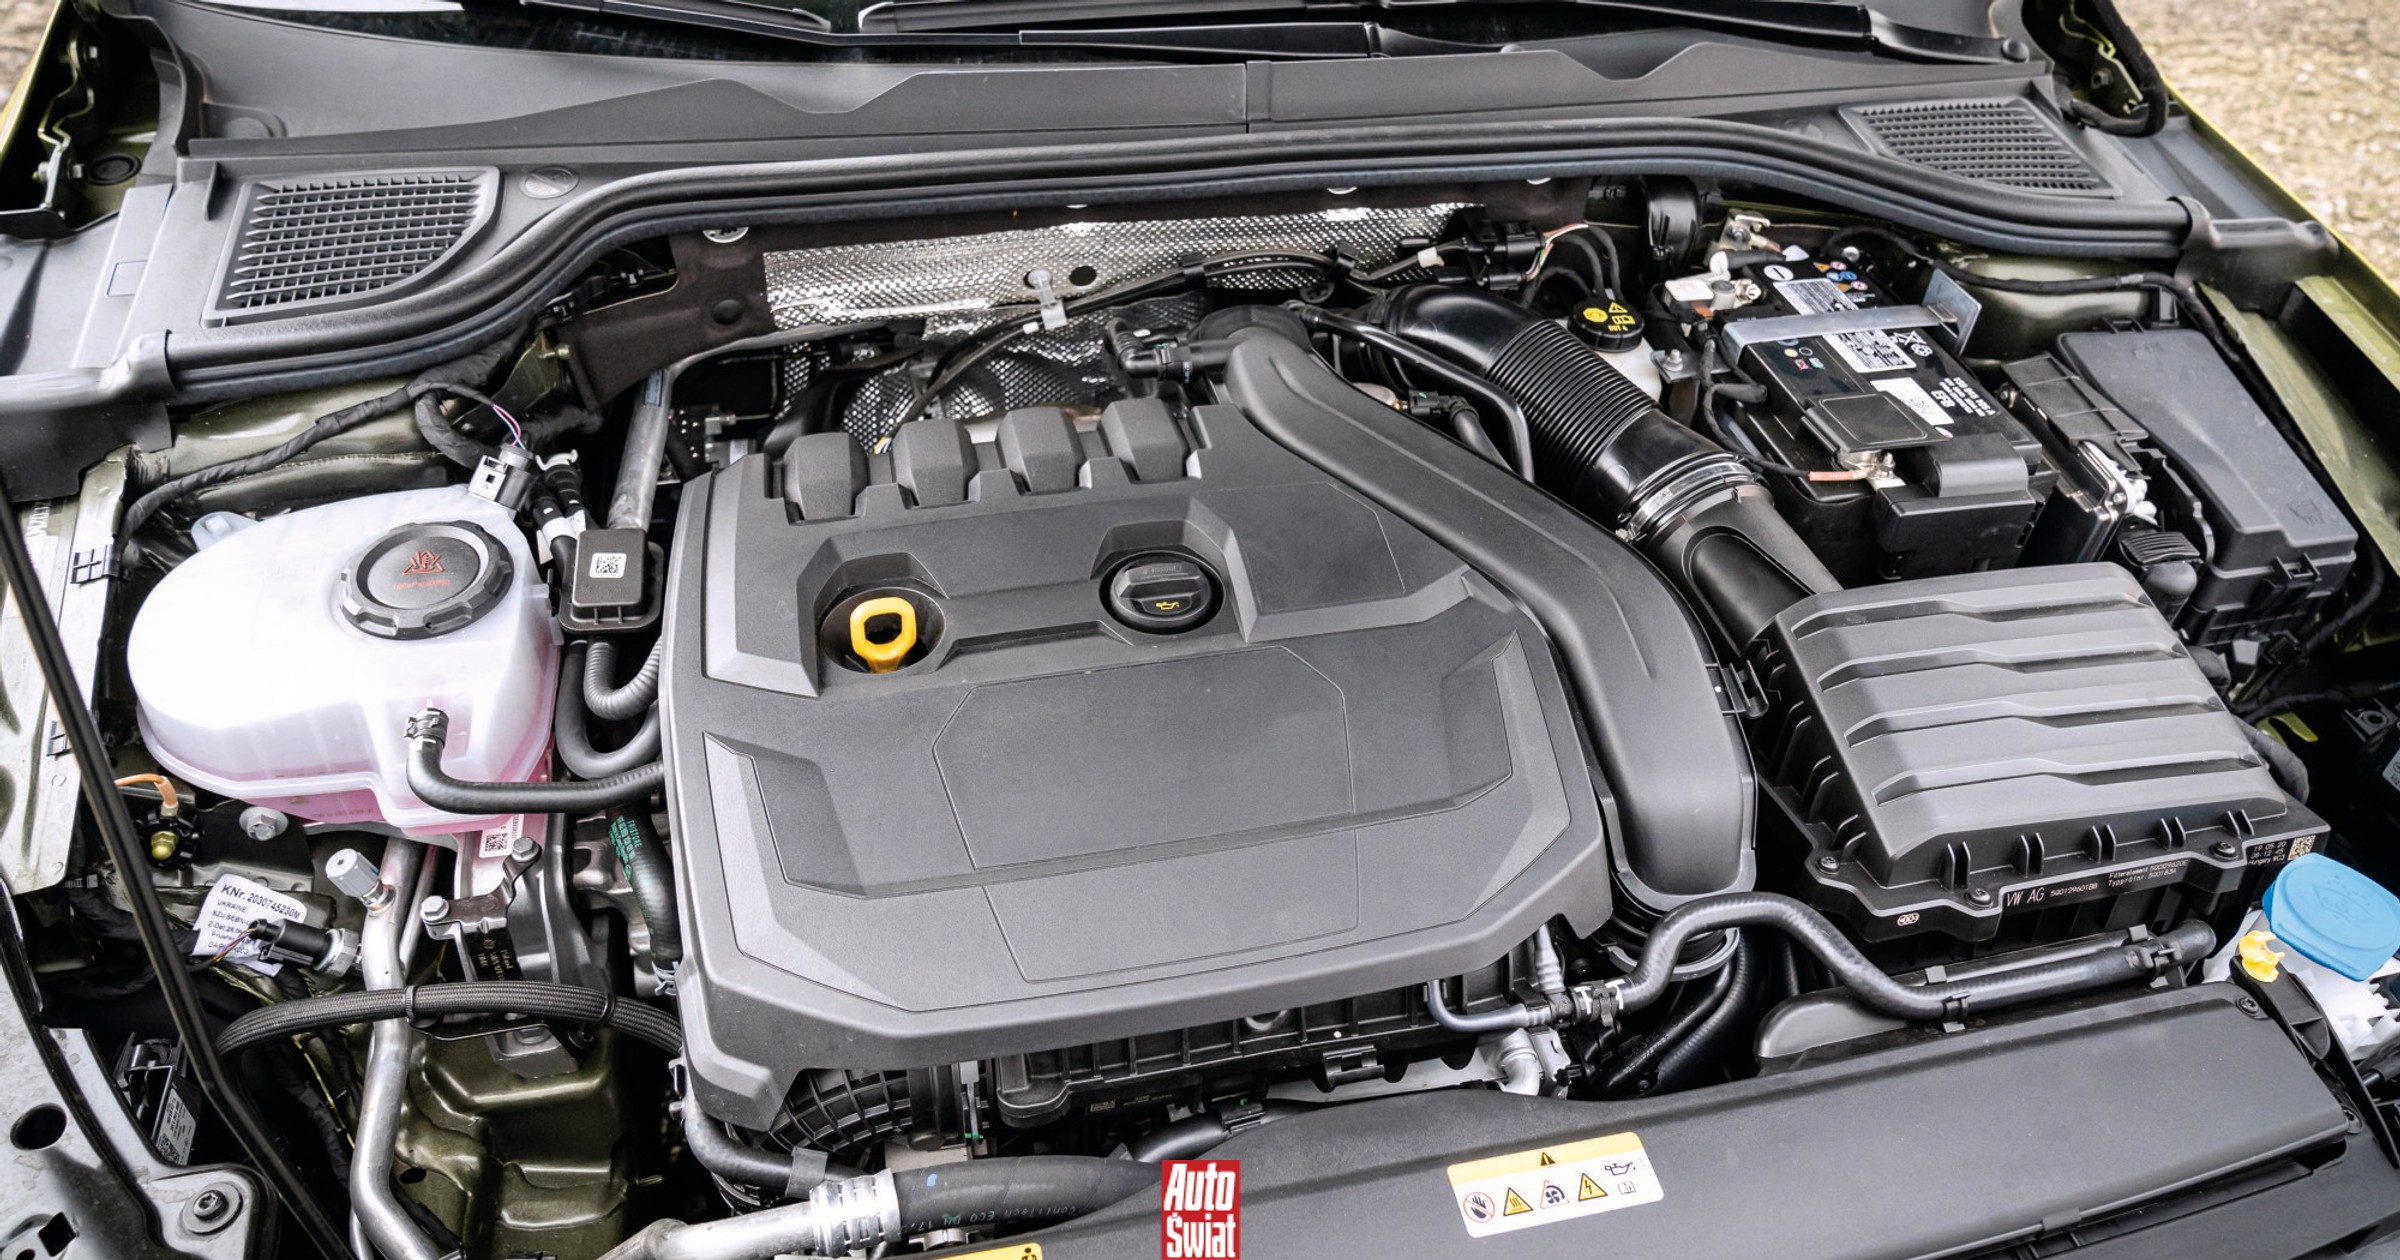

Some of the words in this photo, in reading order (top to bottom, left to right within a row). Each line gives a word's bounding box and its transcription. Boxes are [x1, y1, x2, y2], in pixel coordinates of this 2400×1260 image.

[1931, 389, 1956, 408] EFB
[2006, 890, 2024, 907] VW
[2026, 886, 2045, 904] AG
[970, 1210, 995, 1222] ECO
